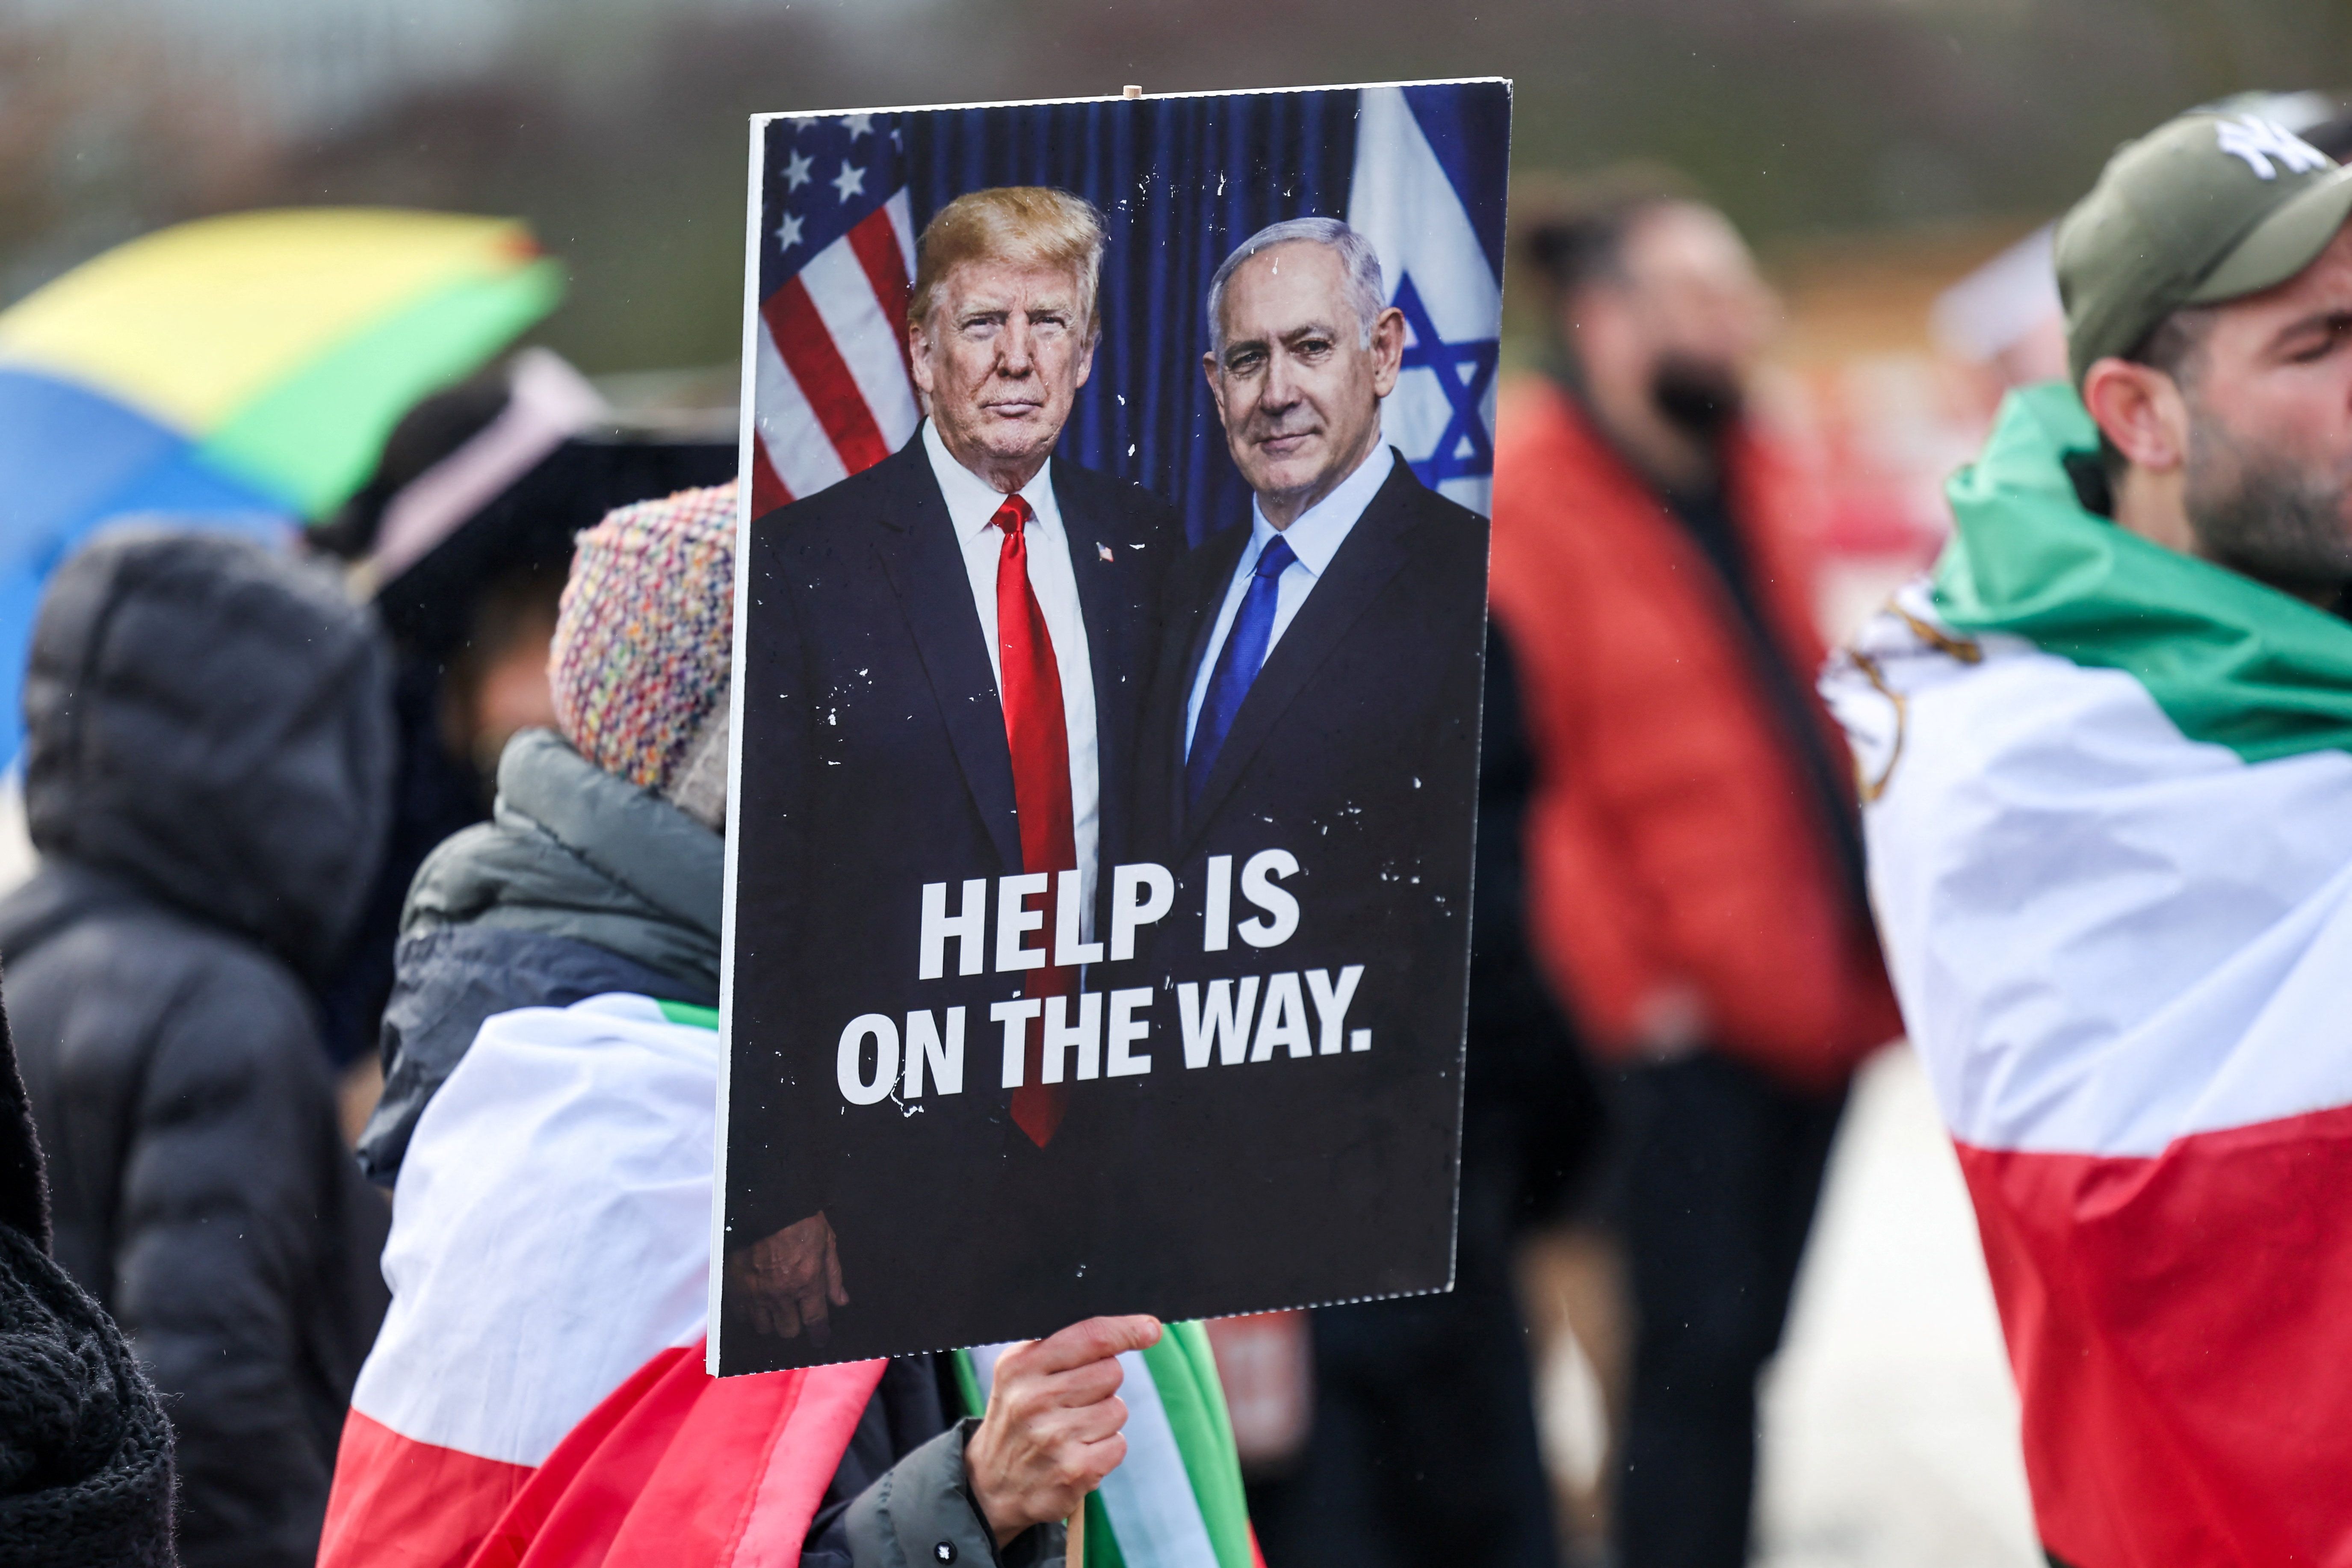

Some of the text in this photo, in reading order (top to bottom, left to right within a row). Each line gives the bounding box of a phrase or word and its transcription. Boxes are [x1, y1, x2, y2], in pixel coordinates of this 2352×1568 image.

[919, 848, 1300, 980] HELP IS
[836, 965, 1372, 1105] ON THE WAY.
